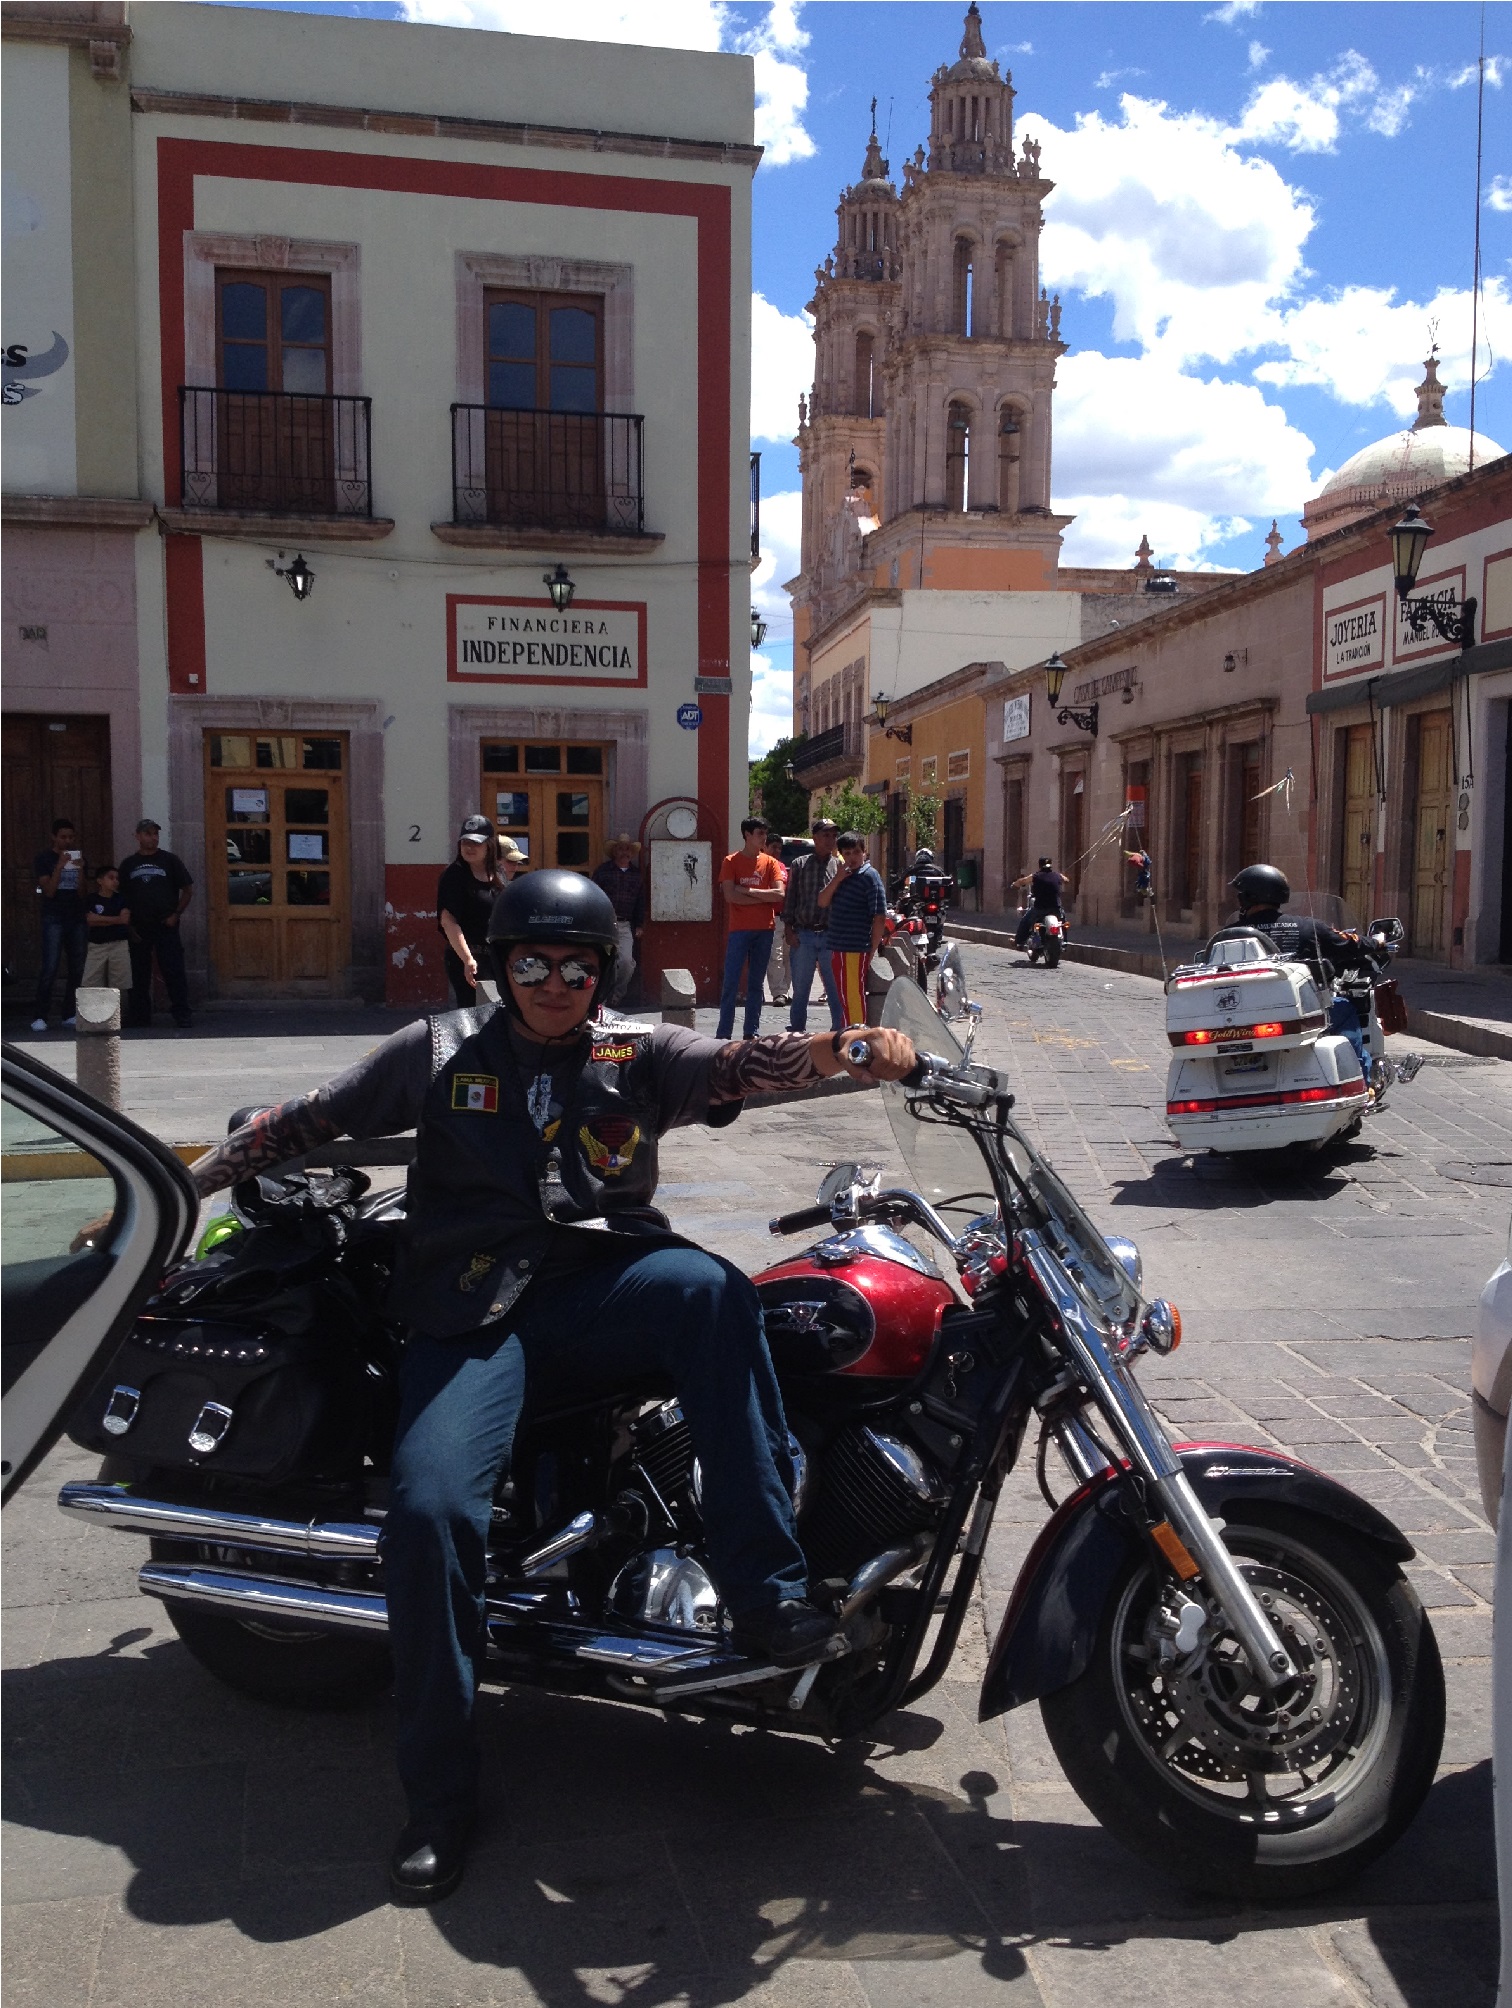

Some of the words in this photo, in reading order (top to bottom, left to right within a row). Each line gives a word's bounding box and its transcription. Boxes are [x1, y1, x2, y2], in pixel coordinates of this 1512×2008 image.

[1400, 587, 1457, 623] FAACIA
[487, 616, 609, 635] FINANCIERA
[1330, 610, 1377, 647] JOYERIA
[462, 639, 632, 669] INDEPENDENCIA
[681, 710, 699, 721] ADT
[408, 824, 422, 843] 2
[596, 1046, 633, 1059] JAMES
